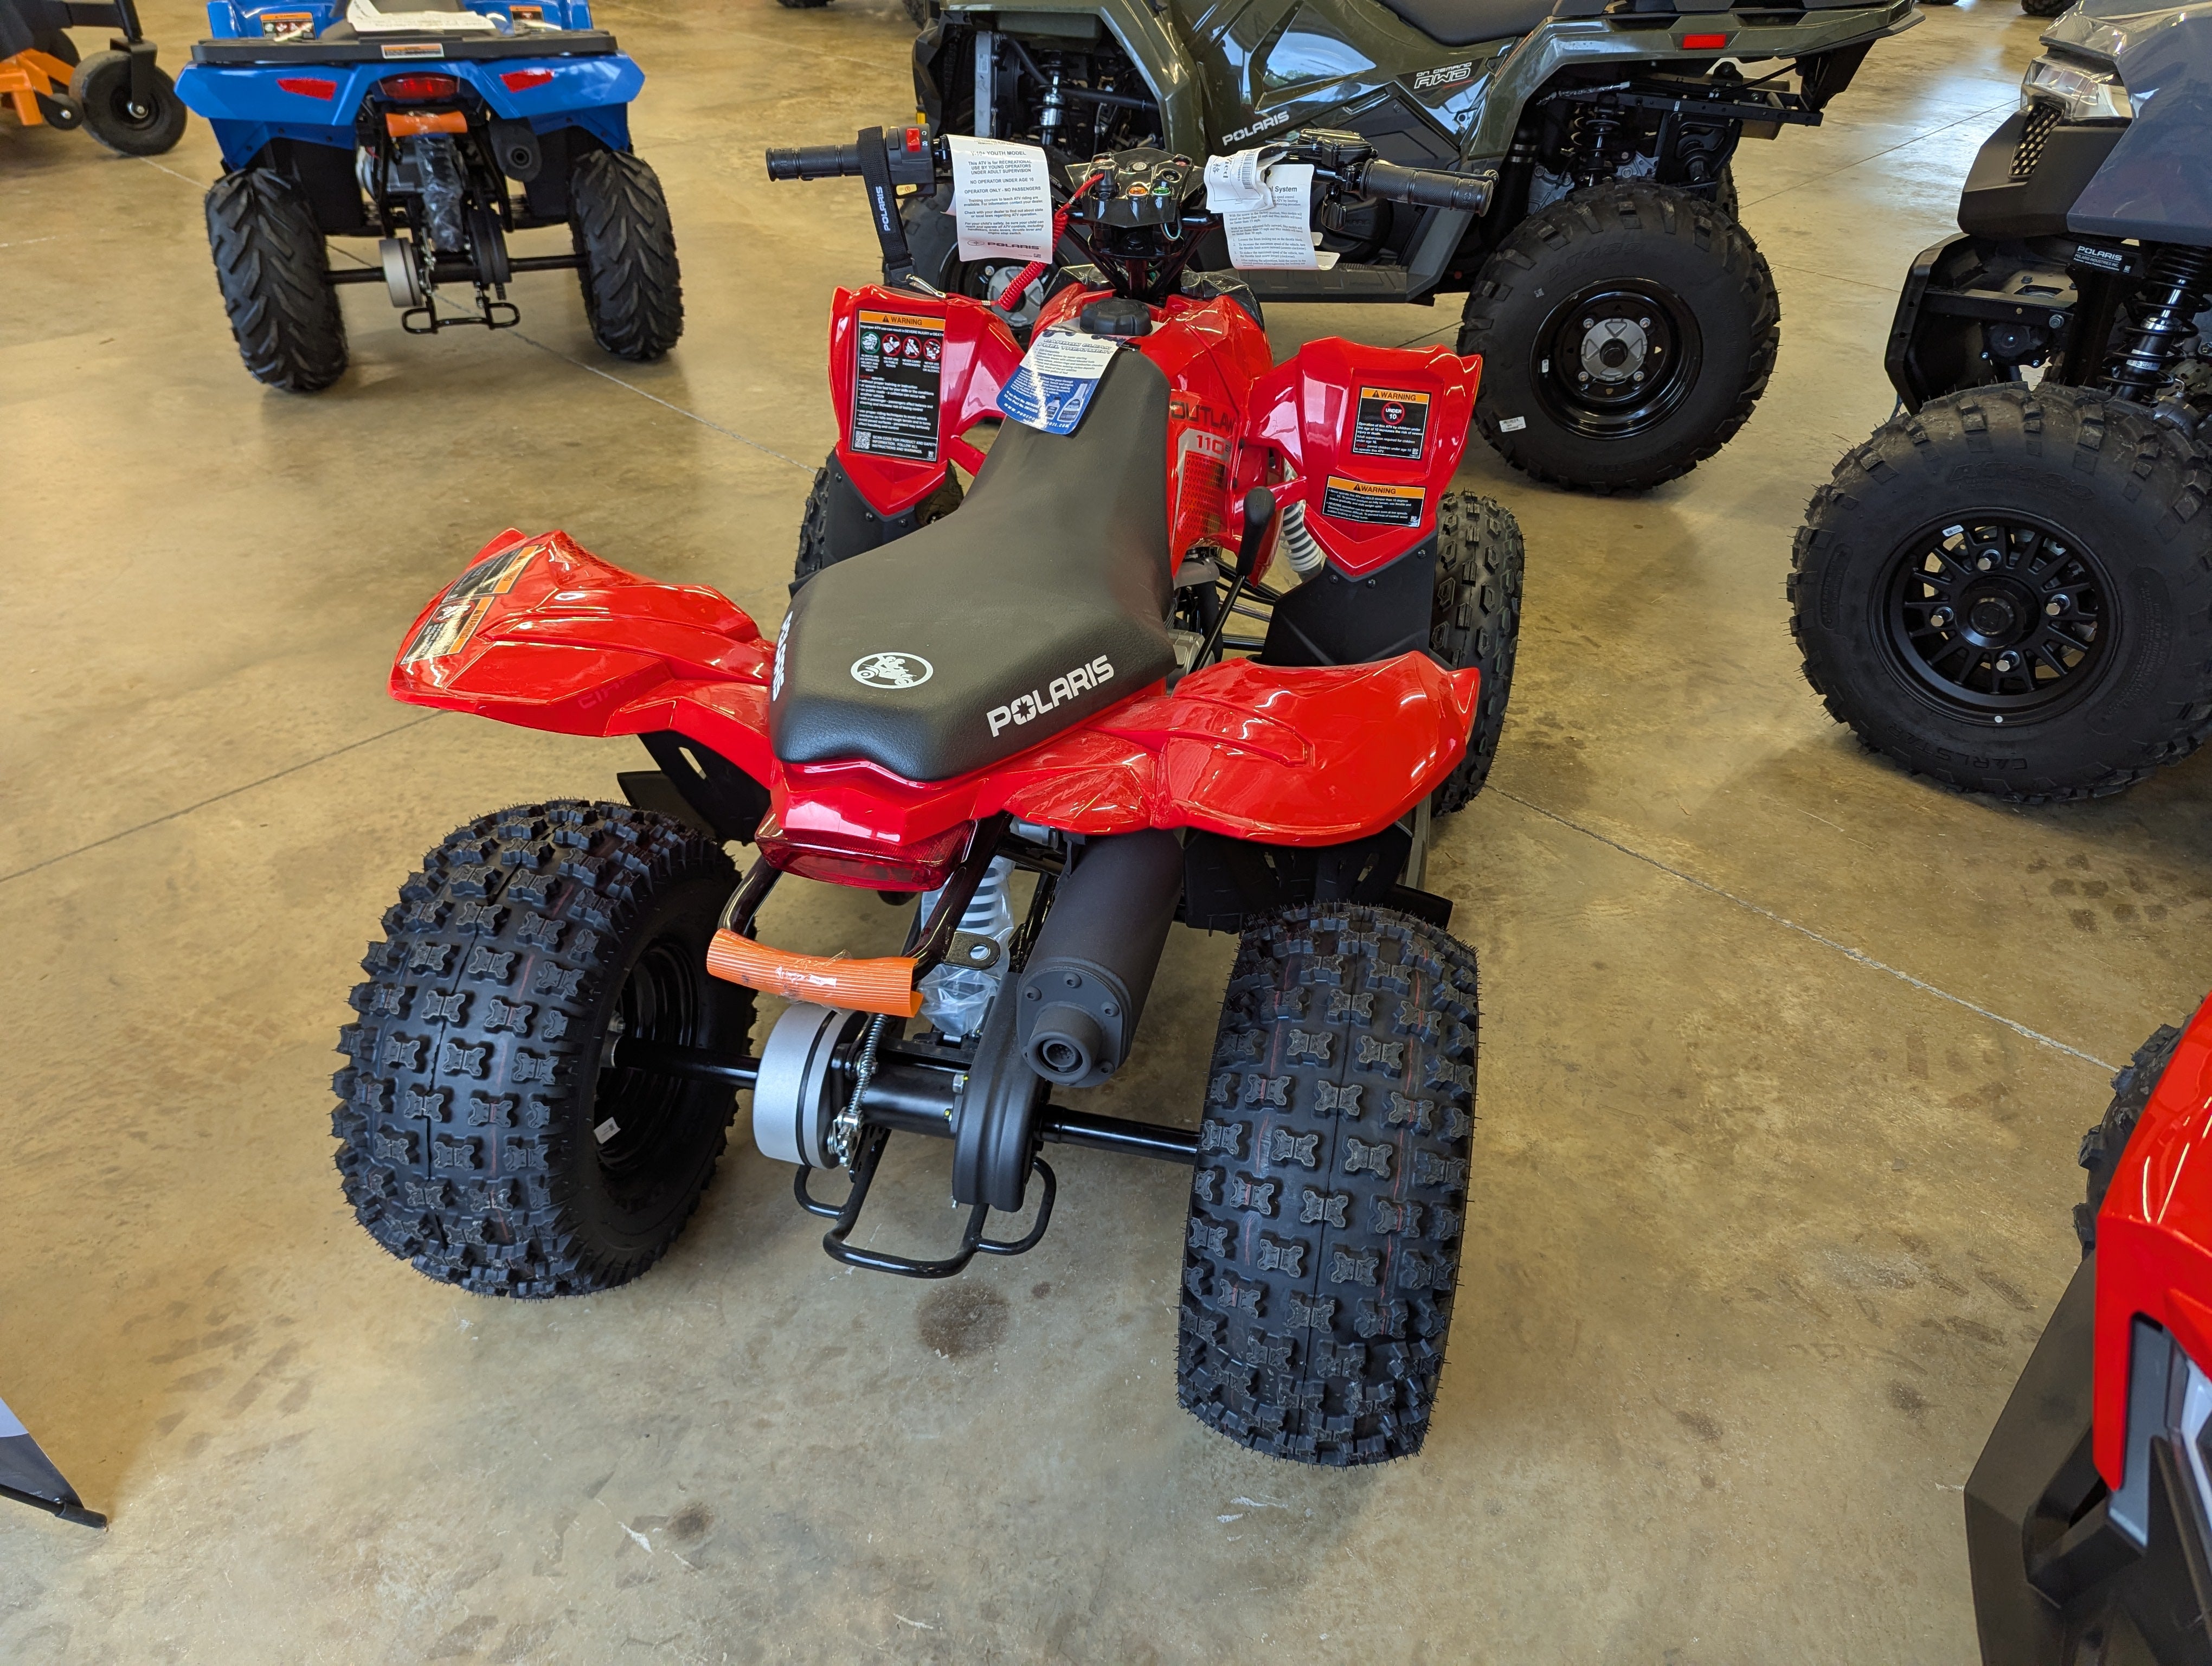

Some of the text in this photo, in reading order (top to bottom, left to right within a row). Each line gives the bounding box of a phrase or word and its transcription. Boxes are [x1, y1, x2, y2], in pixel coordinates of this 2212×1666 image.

[1433, 62, 1472, 74] DEMAND
[1414, 67, 1471, 89] AWD
[1222, 111, 1290, 146] POLARIS
[875, 185, 891, 231] POLARIS
[2077, 246, 2123, 261] POLARIS
[891, 316, 922, 325] WARNING
[1061, 346, 1113, 354] TREATMENT
[1381, 392, 1416, 401] WARNING
[1171, 401, 1236, 435] OUTLAW
[1197, 435, 1224, 454] 110
[1361, 485, 1396, 495] WARNING
[459, 612, 484, 639] WARNING
[986, 654, 1115, 738] POLARIS
